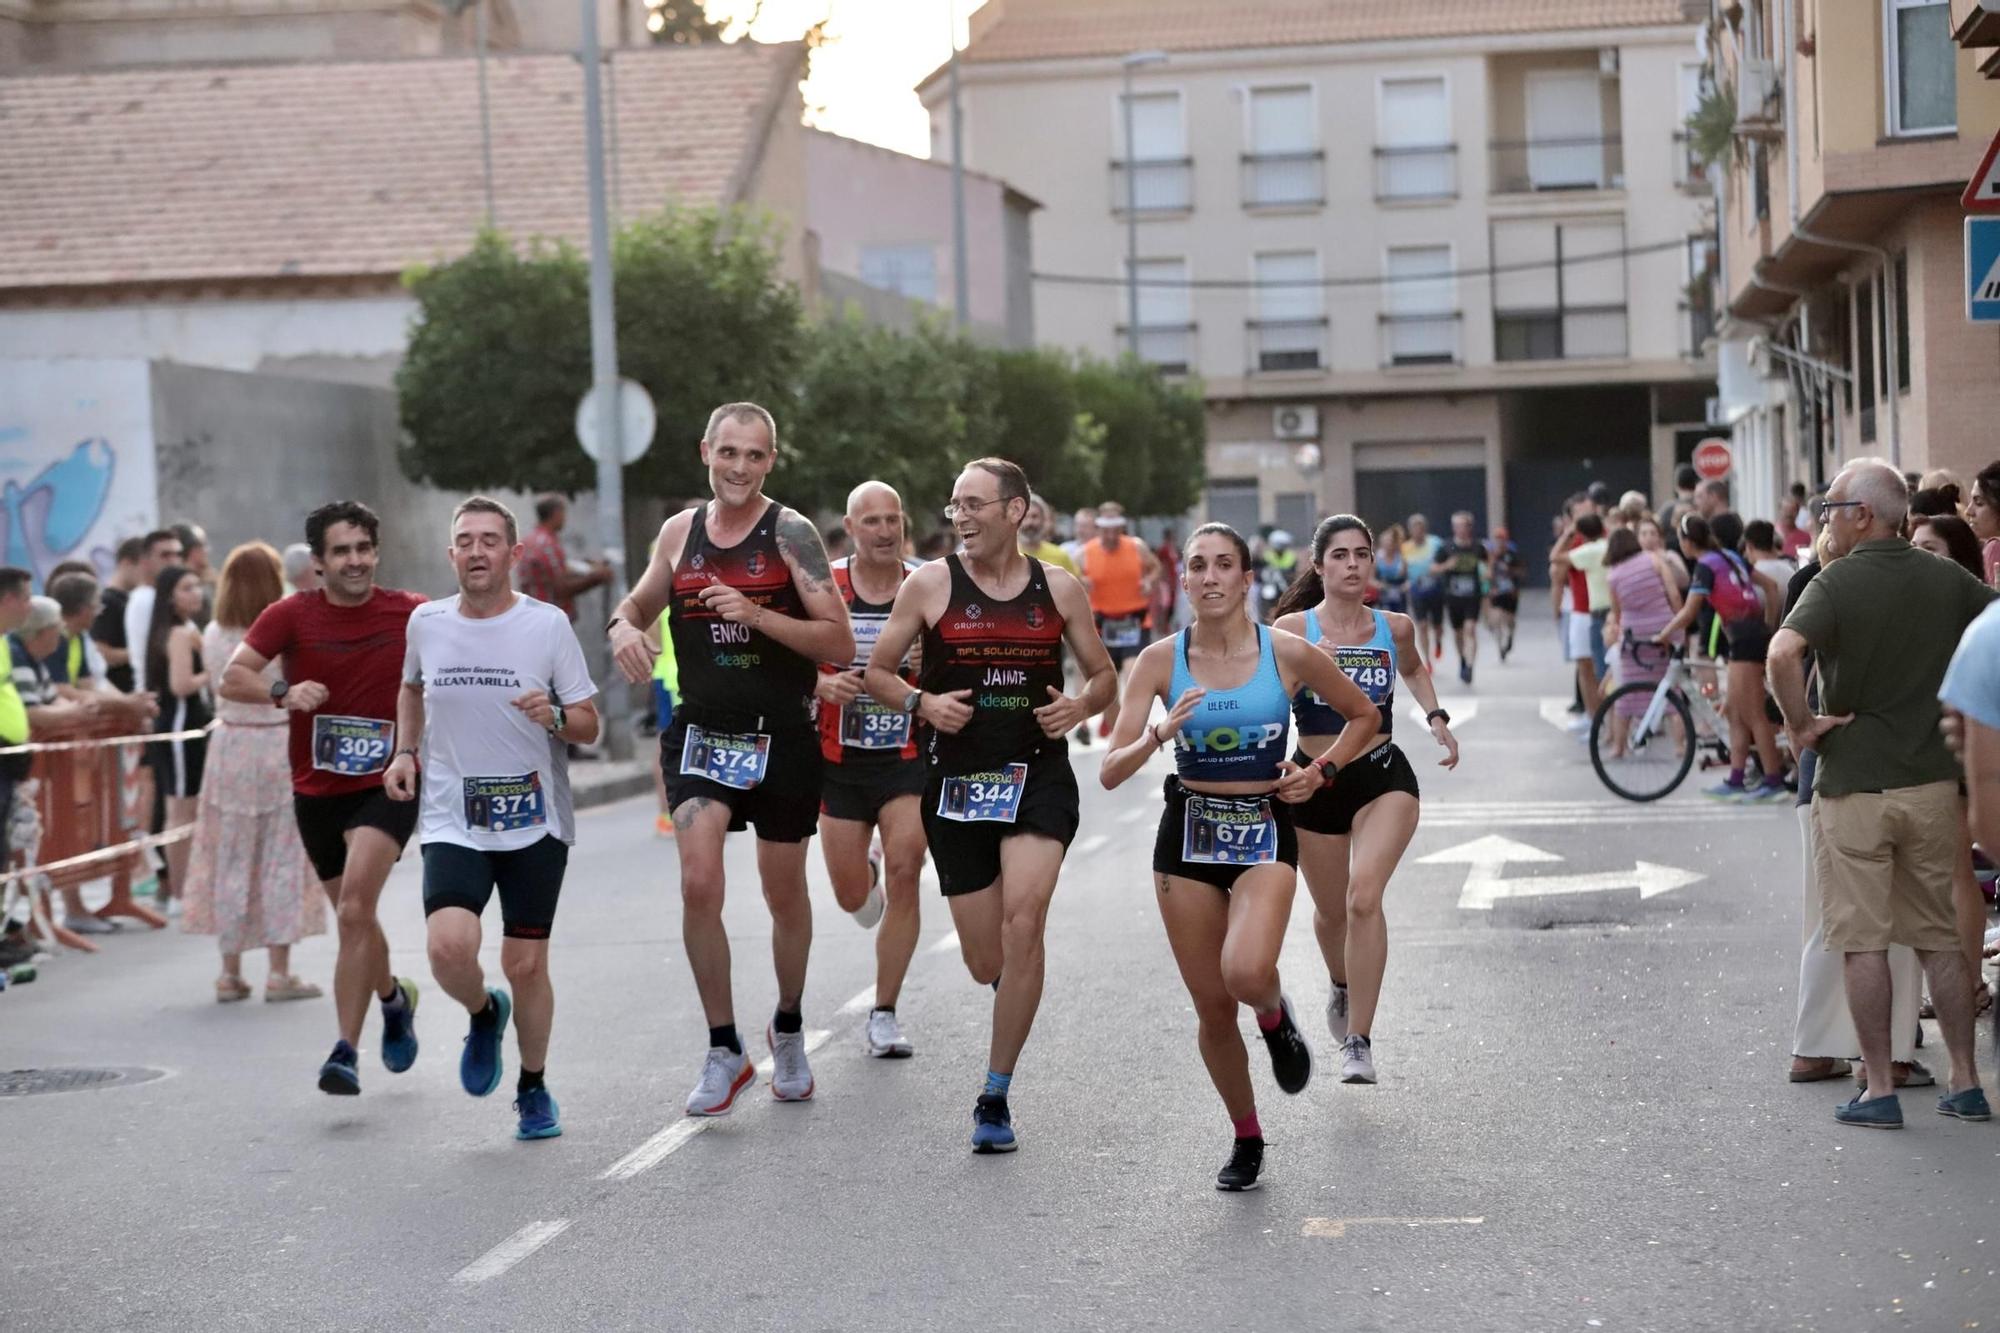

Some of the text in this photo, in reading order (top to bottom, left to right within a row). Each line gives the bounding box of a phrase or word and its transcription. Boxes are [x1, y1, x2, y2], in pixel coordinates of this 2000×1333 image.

[1698, 454, 1729, 467] STOP
[710, 623, 750, 643] ENKO
[954, 621, 984, 630] GRUPO
[983, 647, 1050, 656] SOLUCIONES
[473, 666, 516, 676] Guerrita
[982, 667, 1027, 686] JAIME
[1344, 667, 1388, 687] 748
[432, 676, 521, 688] ALCANTARILLA
[979, 693, 1029, 710] ideagro
[1207, 699, 1240, 711] ULEVEL
[865, 714, 905, 732] 352
[339, 736, 385, 758] 302
[1370, 743, 1388, 762] NIKE
[712, 748, 758, 771] 374
[969, 783, 1015, 803] 344
[491, 792, 537, 815] 371
[1190, 799, 1204, 819] 5
[1216, 823, 1267, 845] 677
